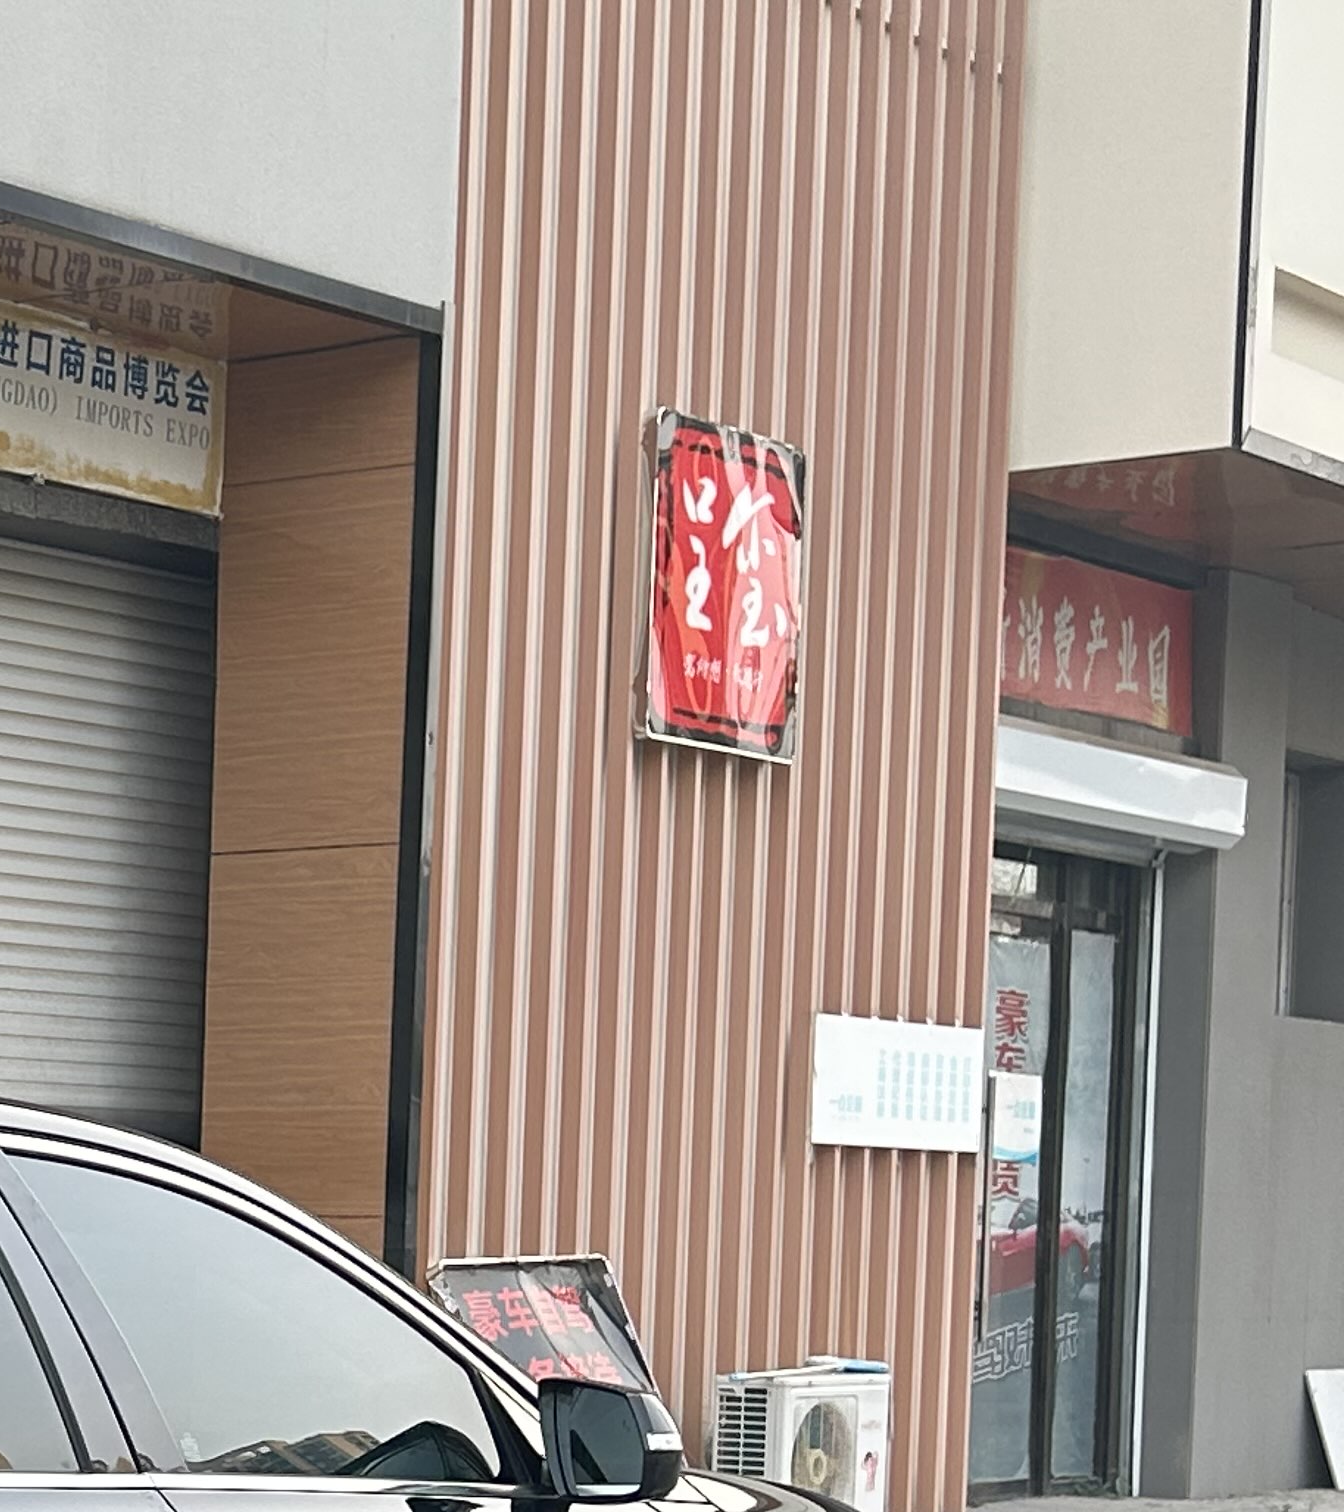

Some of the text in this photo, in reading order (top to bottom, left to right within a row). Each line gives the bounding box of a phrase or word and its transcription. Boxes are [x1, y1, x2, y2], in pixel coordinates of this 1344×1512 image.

[75, 395, 154, 438] IMPORTS
[165, 418, 211, 451] EXPO
[1001, 594, 1171, 707] 消费产业园
